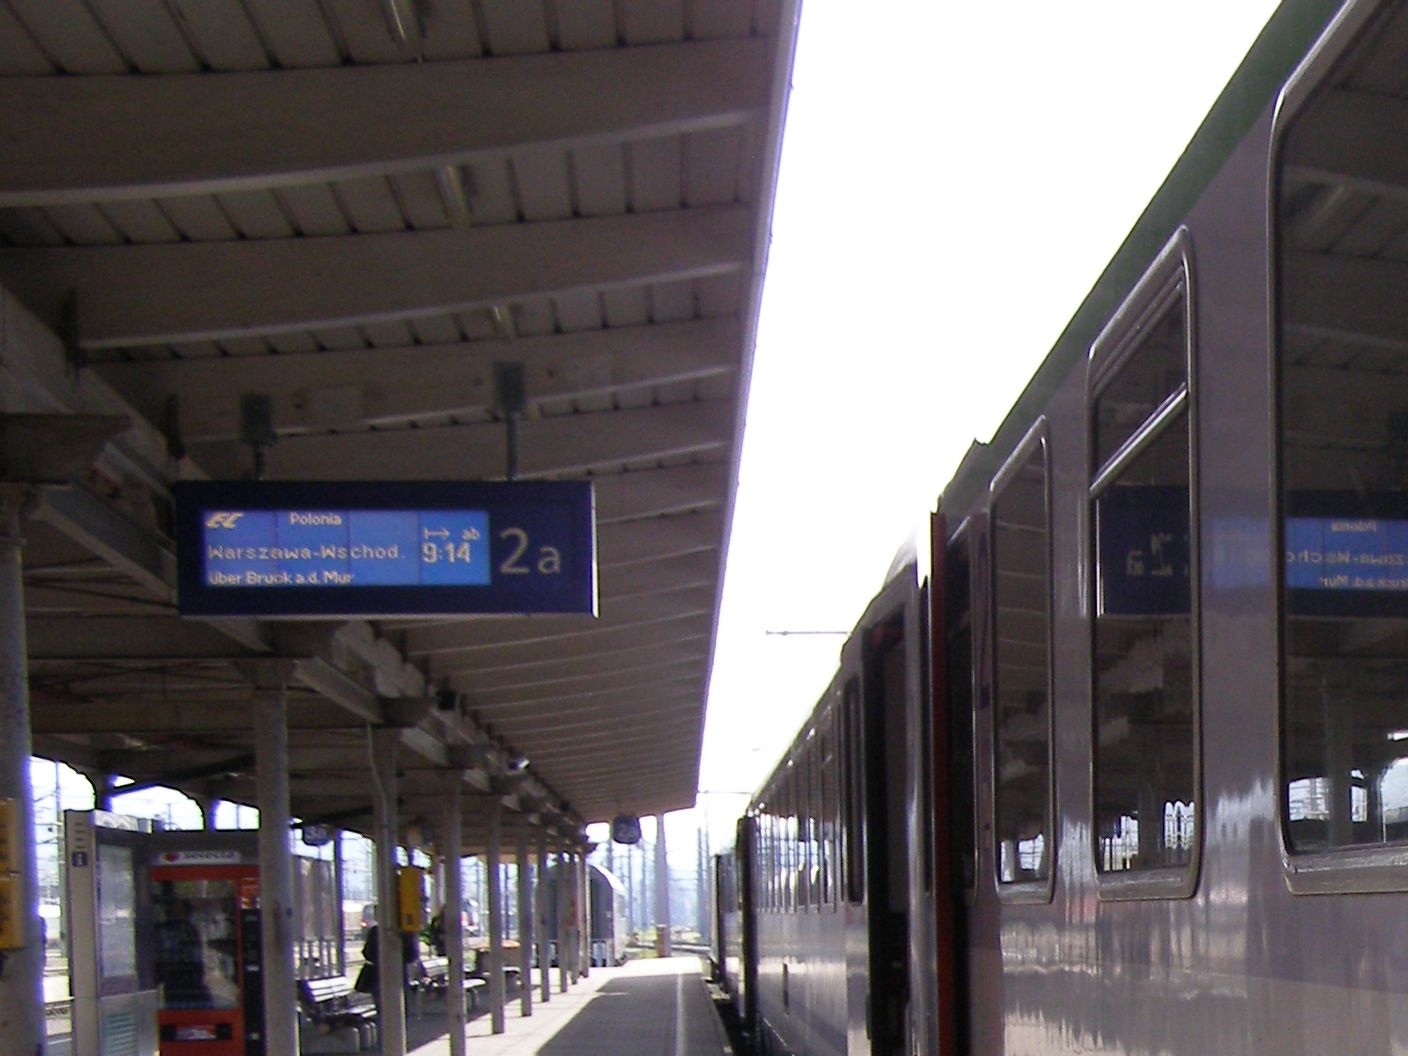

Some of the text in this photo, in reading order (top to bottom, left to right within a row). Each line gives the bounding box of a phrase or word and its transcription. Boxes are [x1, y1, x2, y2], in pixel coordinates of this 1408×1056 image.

[290, 511, 343, 526] Polonia
[462, 526, 480, 541] ab
[208, 541, 471, 564] Warszawa-Wschod. 9:14
[500, 527, 561, 575] 2a
[246, 570, 292, 585] Bruck
[323, 570, 354, 585] Mur
